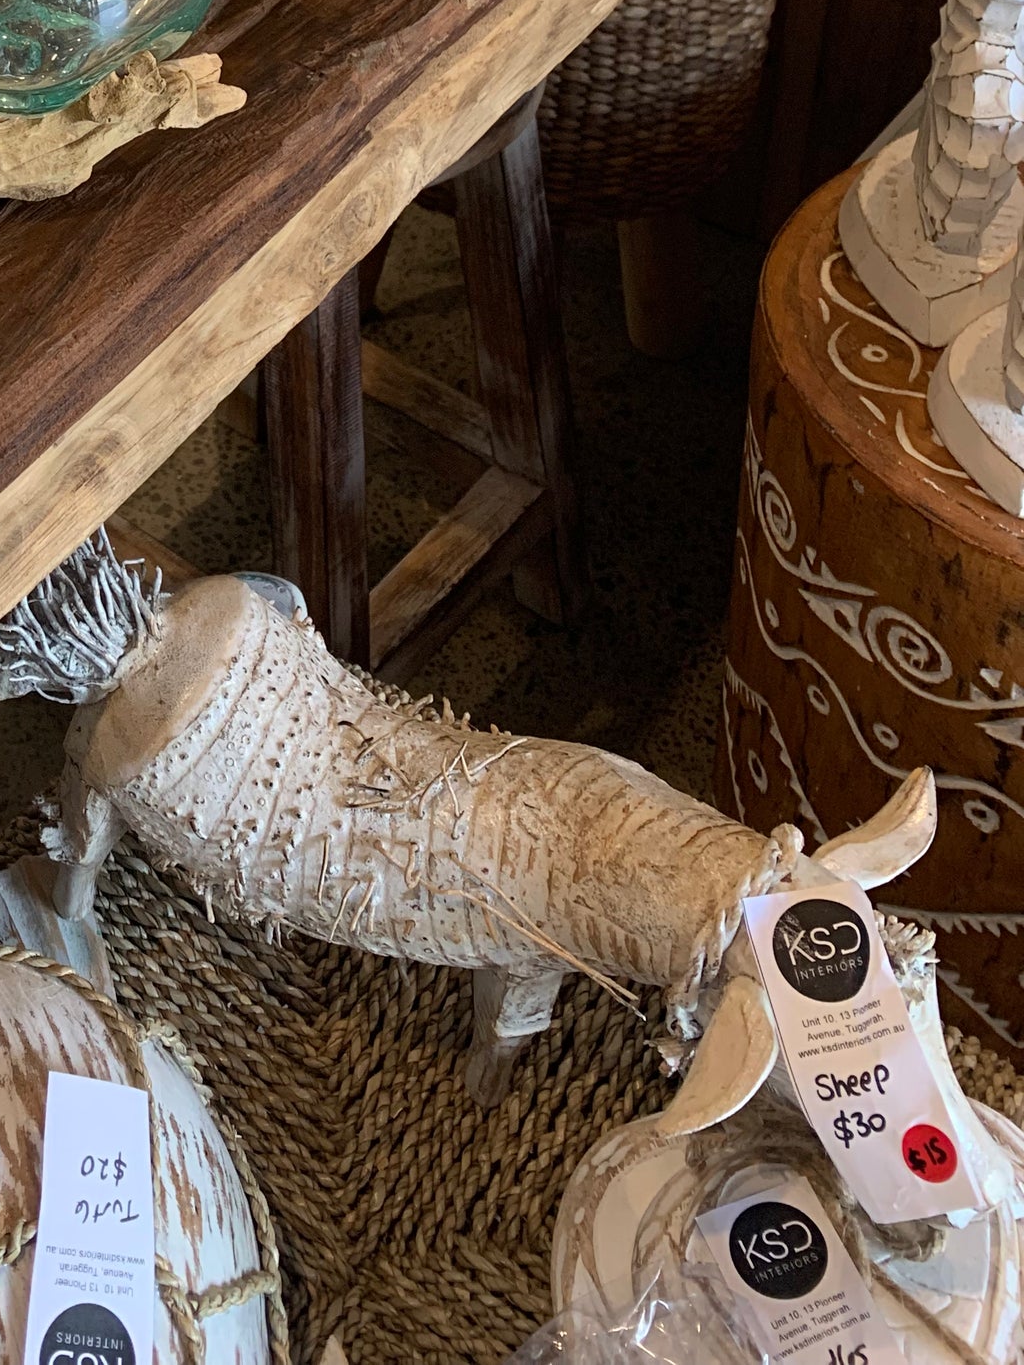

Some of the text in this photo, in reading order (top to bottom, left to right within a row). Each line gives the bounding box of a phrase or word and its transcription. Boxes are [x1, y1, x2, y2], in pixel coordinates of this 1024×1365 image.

[783, 921, 862, 966] KSD
[794, 955, 864, 986] INTERIORS
[801, 1018, 822, 1029] Unit
[839, 1010, 852, 1021] 13
[852, 999, 882, 1018] Pioneer
[814, 1064, 890, 1101] Sheep
[833, 1110, 887, 1149] $30
[80, 1150, 127, 1187] $20
[908, 1136, 948, 1174] $15
[738, 1220, 813, 1269] KSD
[54, 1277, 87, 1292] Pioneer
[755, 1252, 819, 1283] INTERIORS
[88, 1281, 99, 1292] 13
[117, 1285, 134, 1297] Unit
[770, 1315, 789, 1330] Unit
[803, 1303, 814, 1314] 13
[814, 1291, 847, 1309] Pioneer
[55, 1331, 124, 1350] INTERIORS
